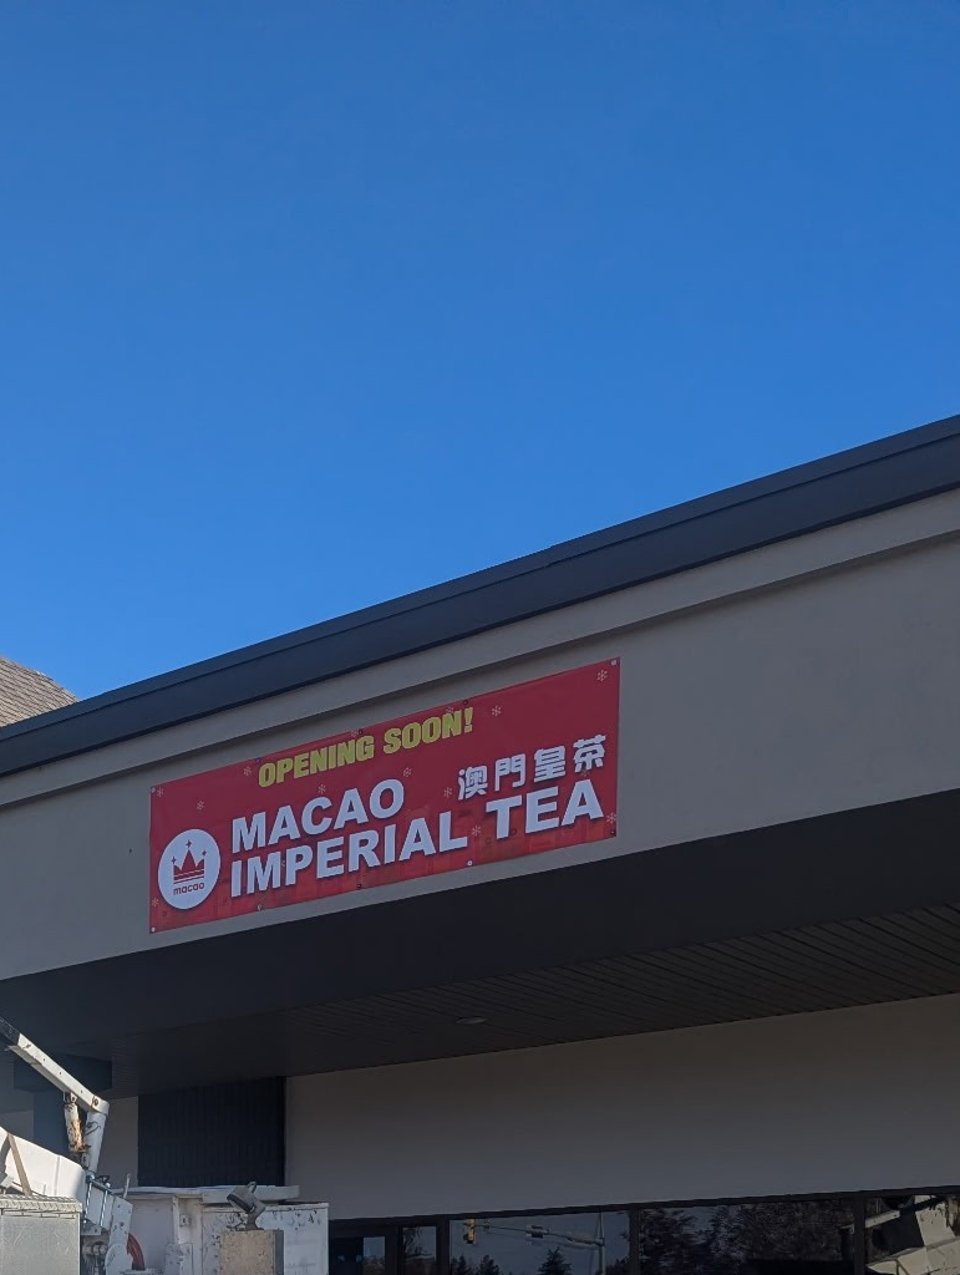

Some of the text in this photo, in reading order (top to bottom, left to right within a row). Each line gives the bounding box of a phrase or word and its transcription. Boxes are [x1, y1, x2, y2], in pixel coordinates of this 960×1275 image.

[258, 707, 474, 787] OPENING SOON!
[458, 734, 607, 800] 澳門皇茶
[231, 779, 605, 898] IMPERIAL TEA
[232, 778, 404, 853] MACAO
[173, 883, 205, 896] macao
